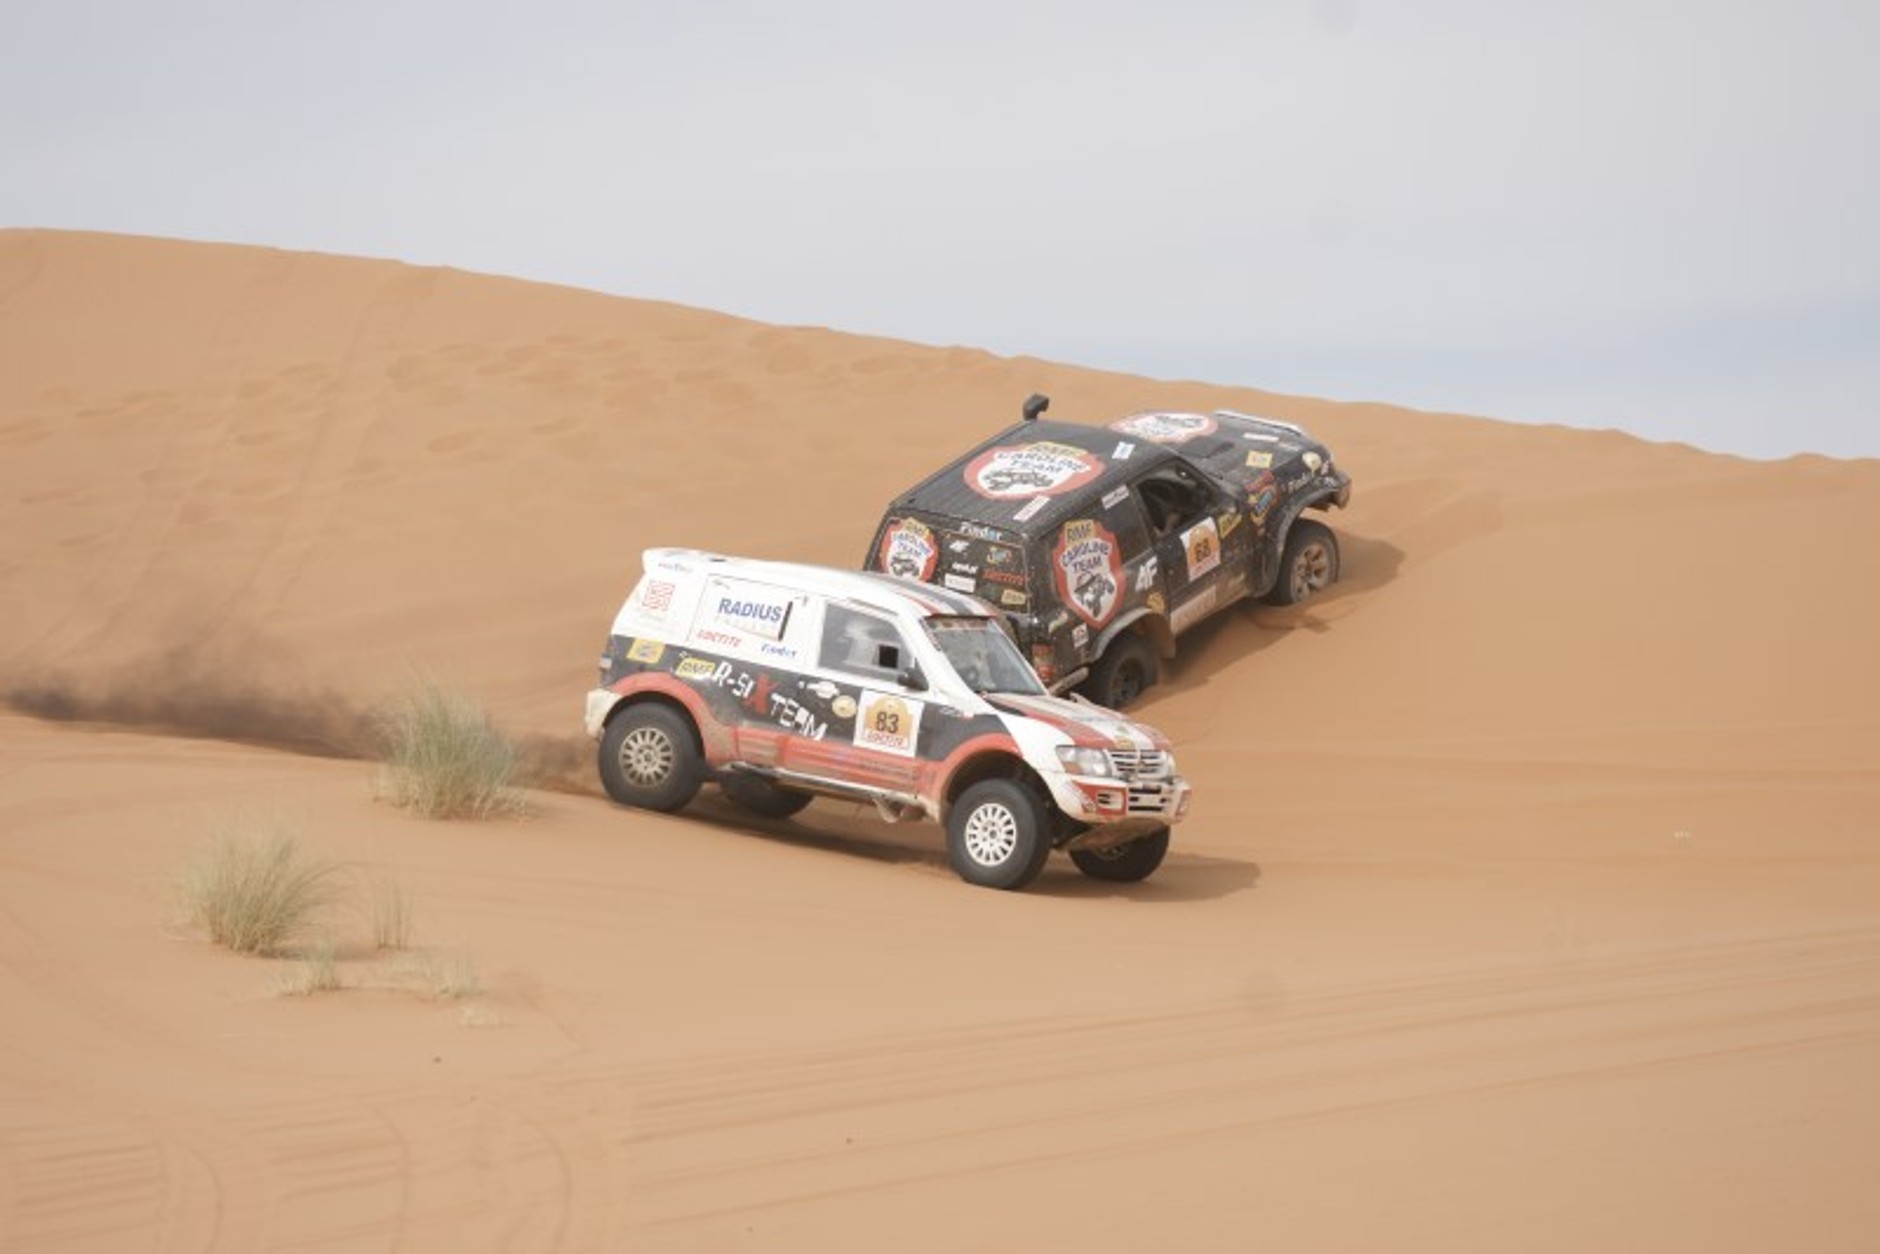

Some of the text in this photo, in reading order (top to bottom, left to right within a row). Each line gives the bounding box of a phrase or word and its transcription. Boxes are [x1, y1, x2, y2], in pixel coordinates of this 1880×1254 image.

[1067, 523, 1092, 543] RMF
[1062, 540, 1109, 567] CAROLINE
[1072, 556, 1103, 573] TEAM
[719, 598, 783, 622] RADIUS
[770, 692, 828, 741] TEAM
[876, 711, 899, 734] 83
